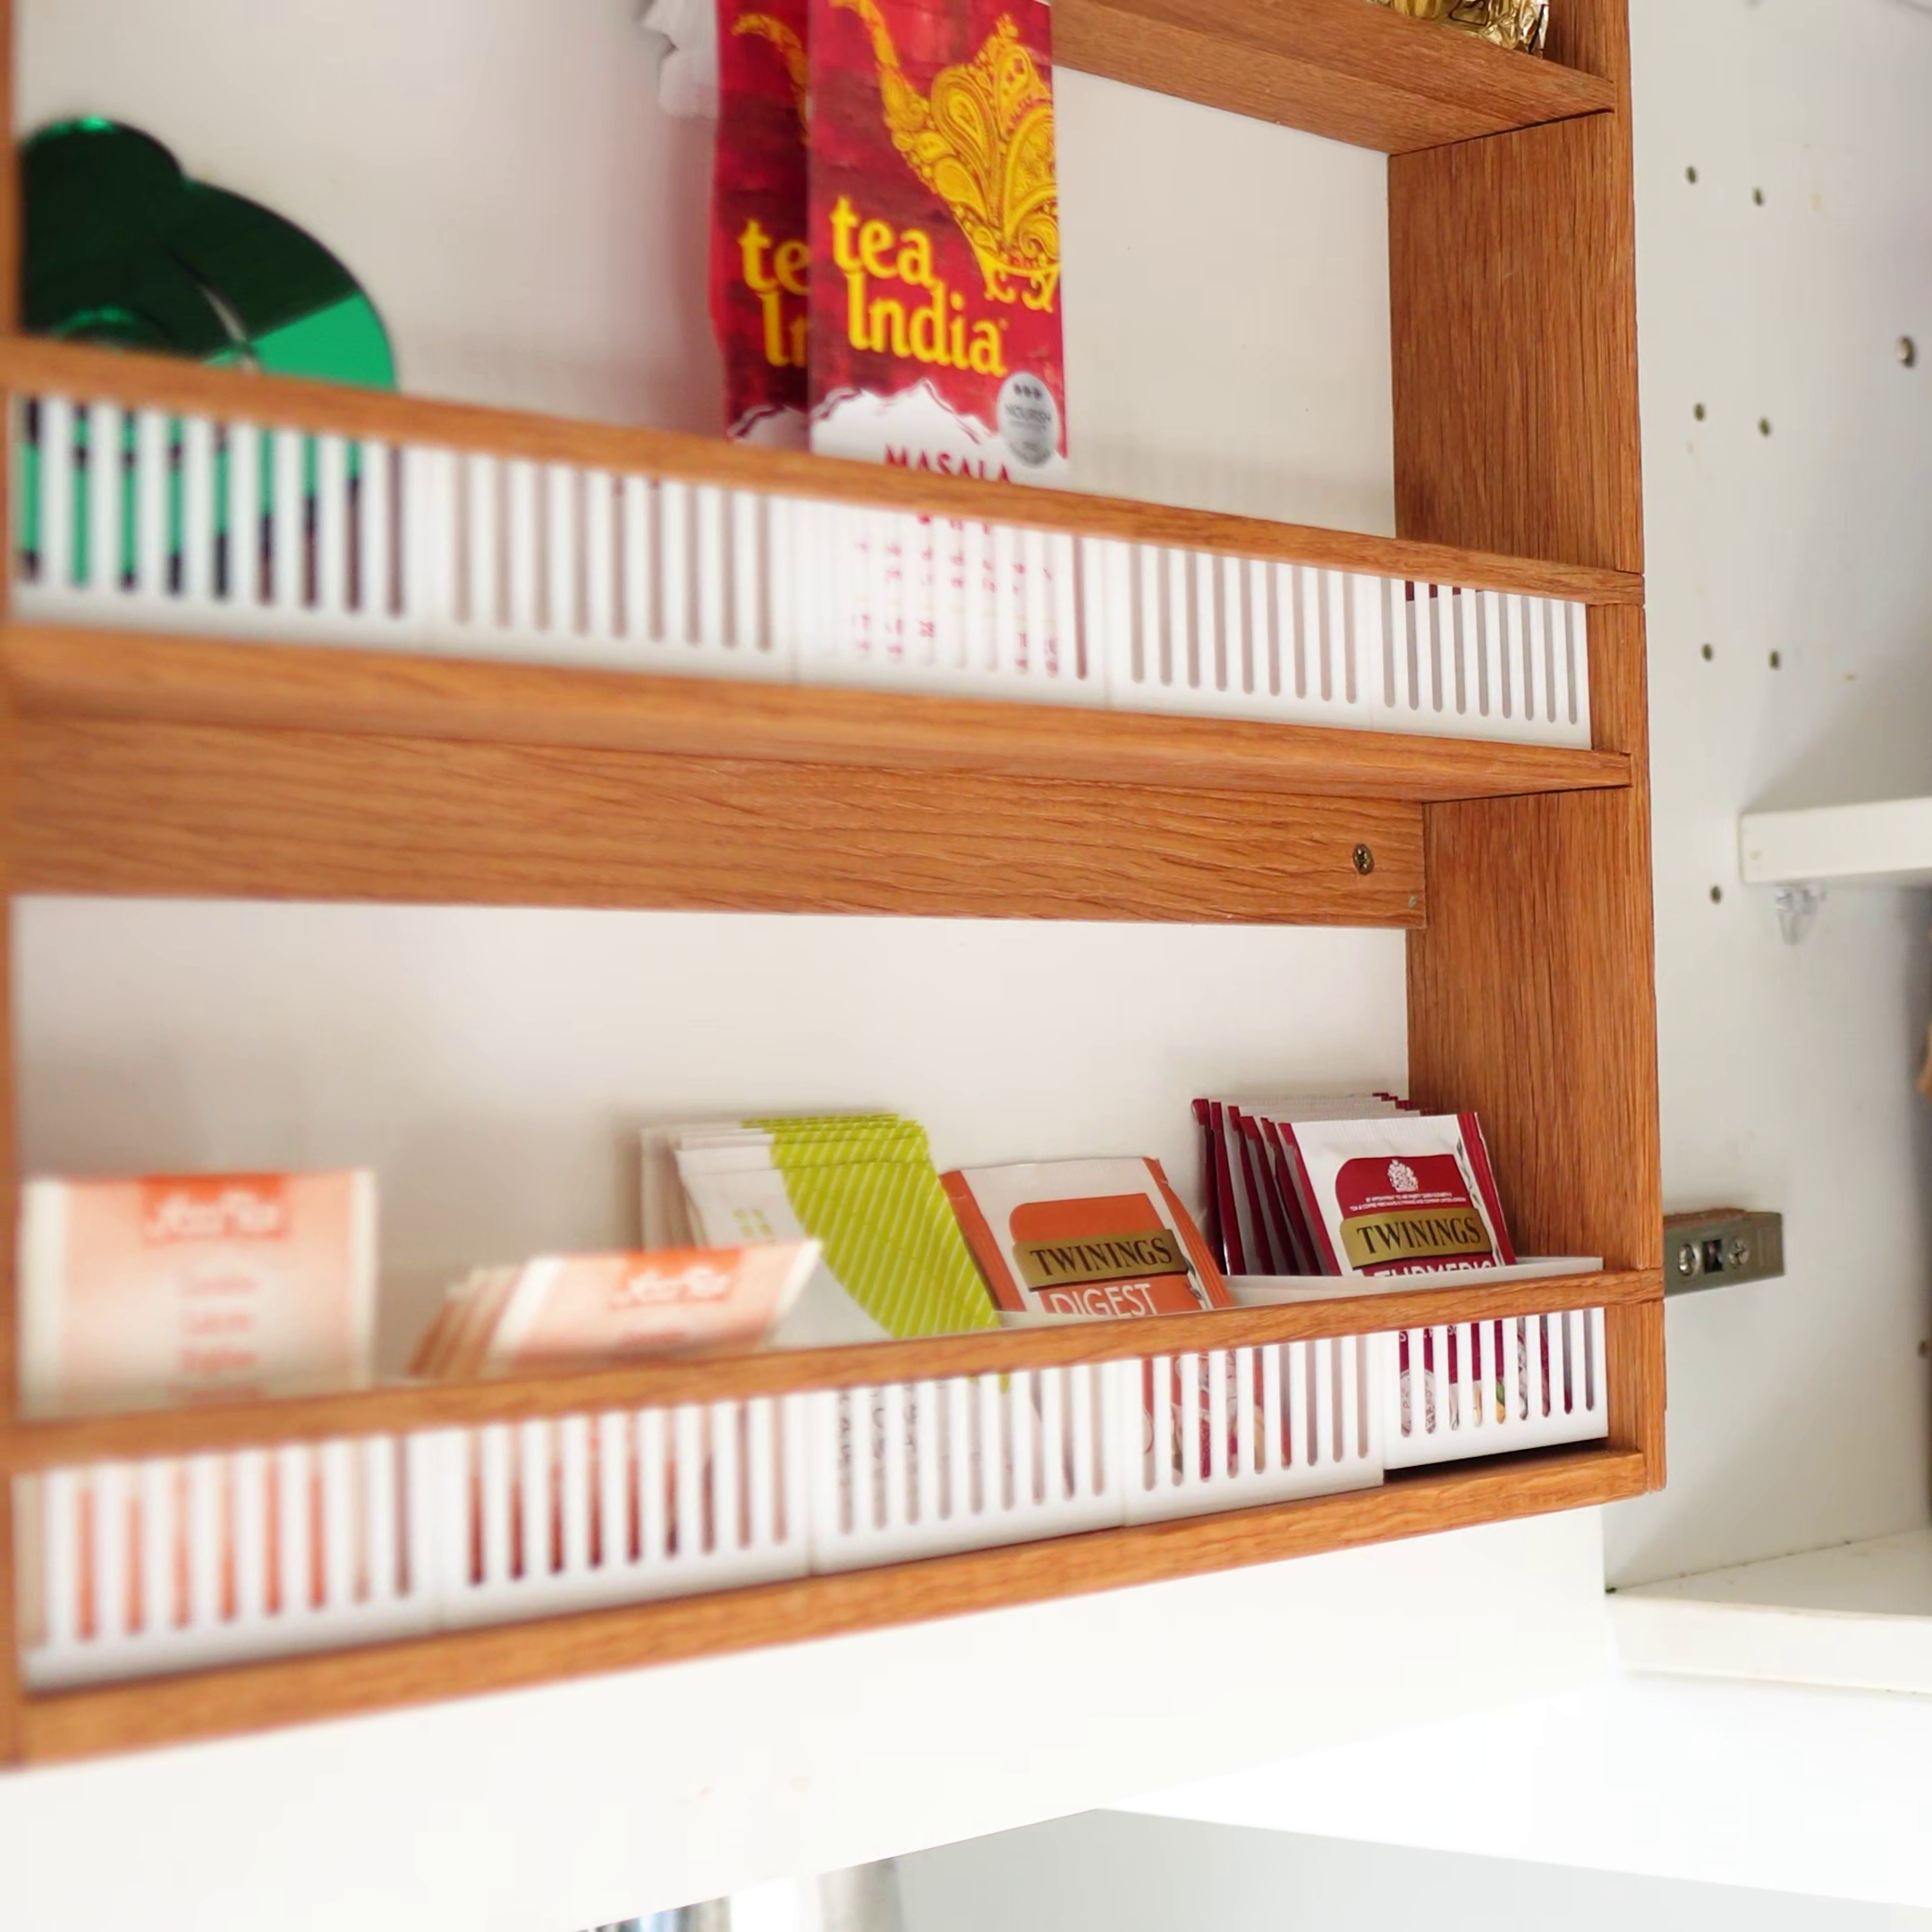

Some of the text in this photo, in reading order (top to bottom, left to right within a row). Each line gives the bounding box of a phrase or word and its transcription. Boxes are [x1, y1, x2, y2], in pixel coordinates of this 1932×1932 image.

[738, 218, 809, 296] te
[830, 195, 936, 289] tea
[844, 267, 1008, 377] India
[1029, 1237, 1173, 1276] TWININGS
[1356, 1216, 1481, 1254] TWININGS
[1049, 1283, 1157, 1317] DIGEST
